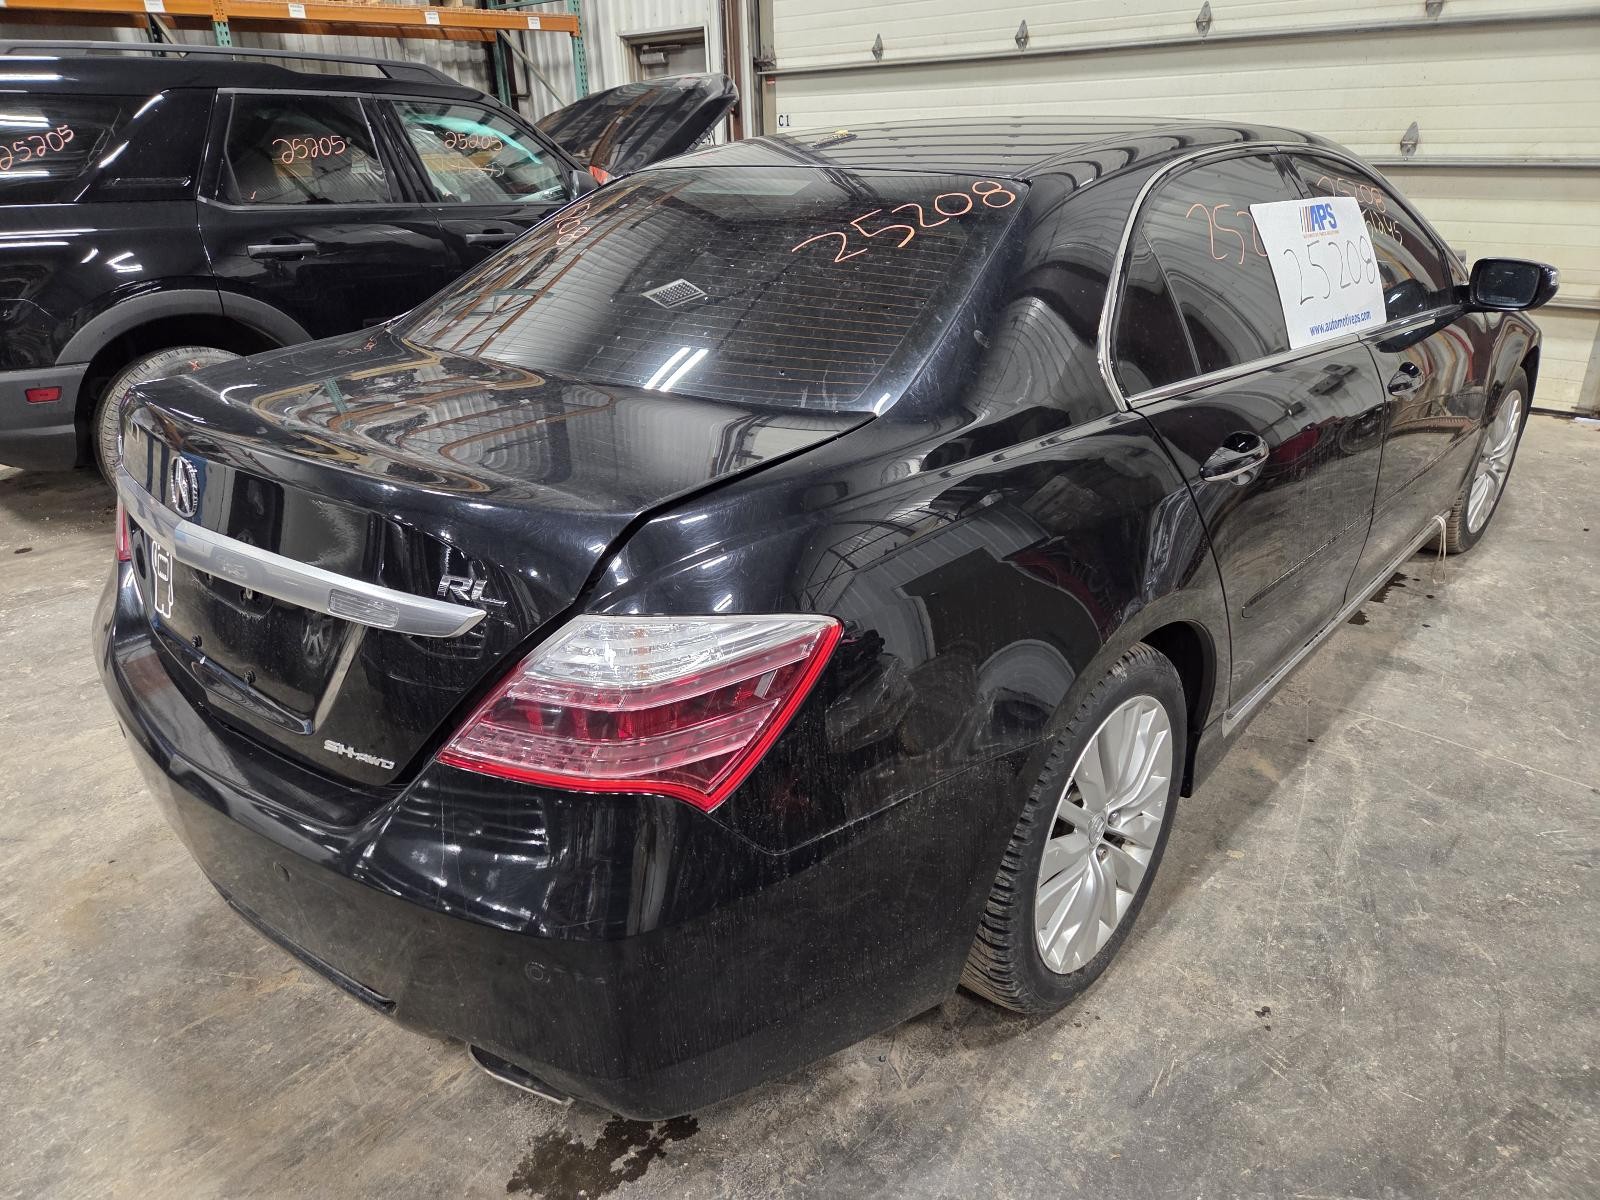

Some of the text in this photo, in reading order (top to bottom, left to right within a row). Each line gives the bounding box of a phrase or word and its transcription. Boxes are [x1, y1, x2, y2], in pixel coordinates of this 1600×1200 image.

[778, 114, 790, 127] C1
[0, 125, 74, 171] 25205
[272, 135, 346, 164] 25205
[444, 131, 503, 151] 25205
[791, 180, 1016, 263] 25208
[1310, 202, 1338, 232] APS
[1283, 235, 1376, 306] 25208
[437, 574, 507, 607] RL
